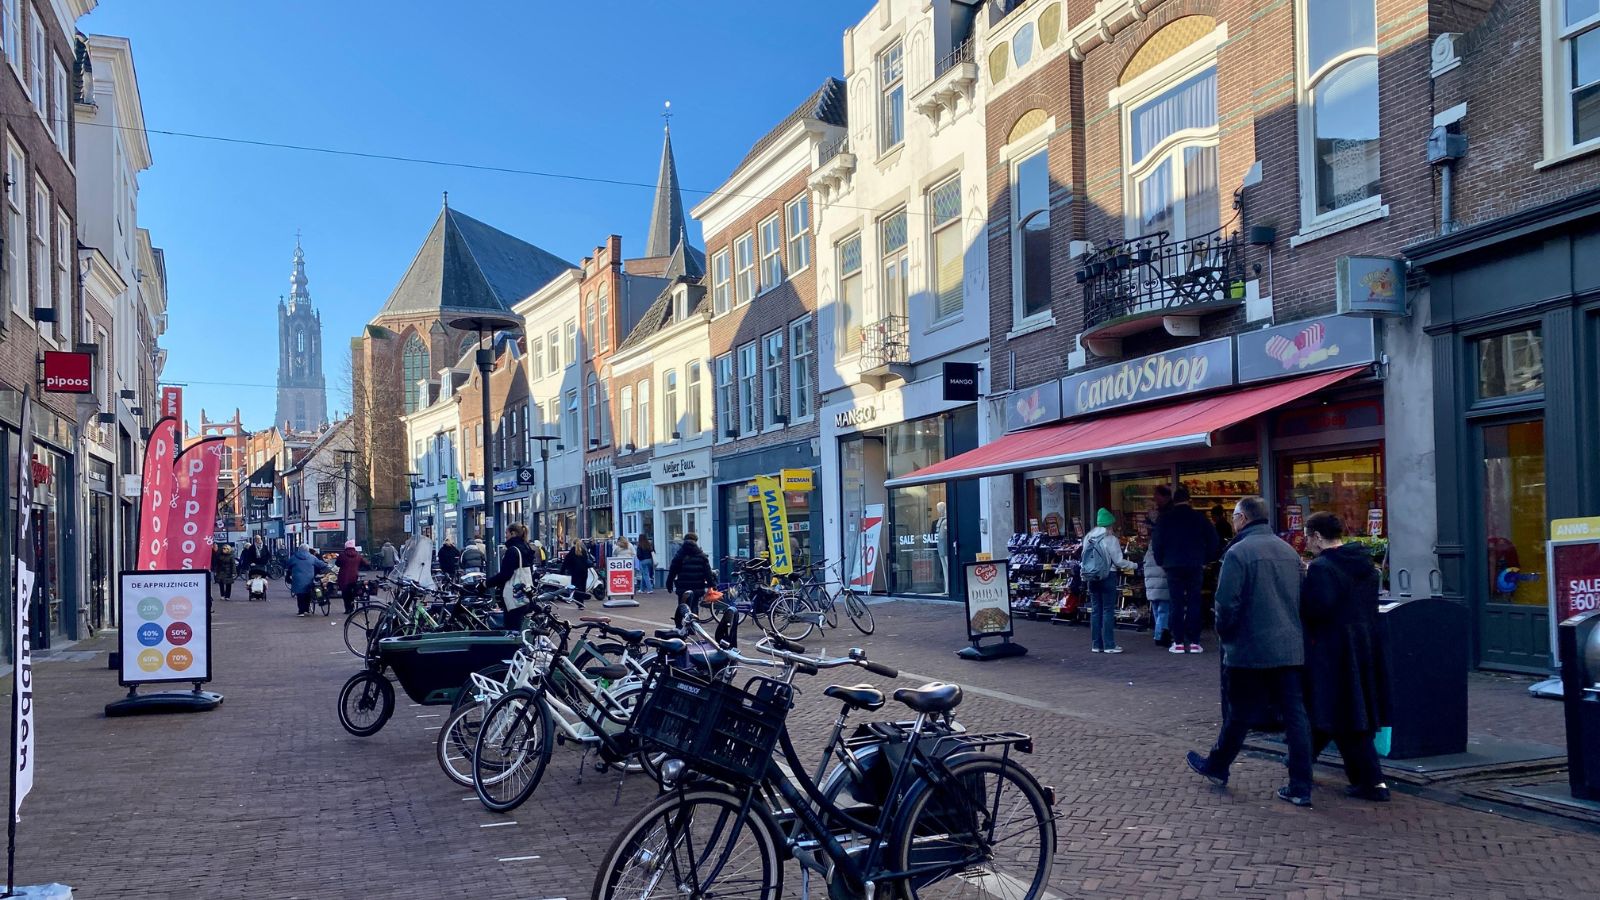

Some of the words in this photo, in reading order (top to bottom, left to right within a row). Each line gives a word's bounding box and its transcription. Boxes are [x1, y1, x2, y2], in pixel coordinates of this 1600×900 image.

[46, 376, 89, 387] pipoos
[1077, 354, 1209, 412] CandyShop
[835, 405, 875, 428] MANGO
[150, 438, 166, 570] pipoos
[181, 458, 204, 570] pipoos
[1556, 523, 1589, 536] ANWB
[899, 535, 915, 545] SALE
[923, 533, 938, 544] SALE
[609, 560, 632, 570] sale
[612, 577, 629, 586] 50%
[1570, 579, 1600, 594] SALE
